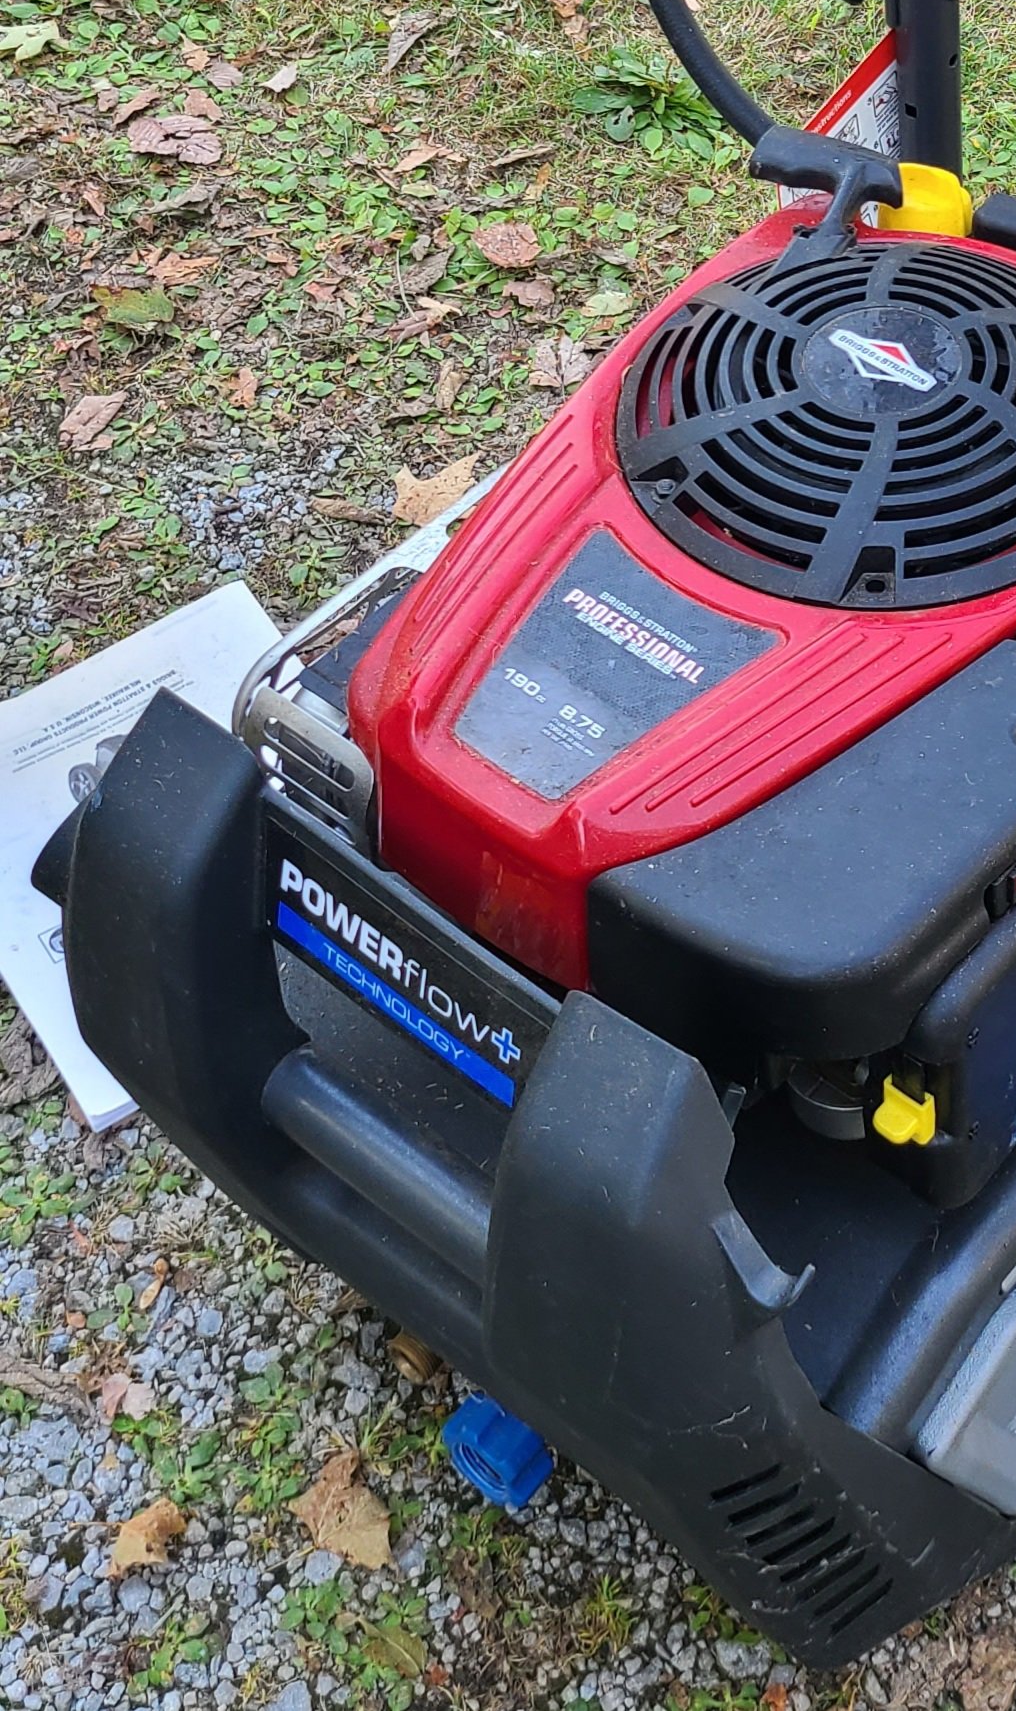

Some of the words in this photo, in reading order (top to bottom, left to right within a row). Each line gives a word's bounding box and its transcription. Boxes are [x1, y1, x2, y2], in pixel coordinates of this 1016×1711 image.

[562, 588, 704, 684] PROFESSIONAL
[575, 612, 626, 645] ENGINE
[624, 642, 674, 675] SERIES
[559, 704, 607, 739] 8.75
[323, 942, 465, 1061] TECHNOLOGY
